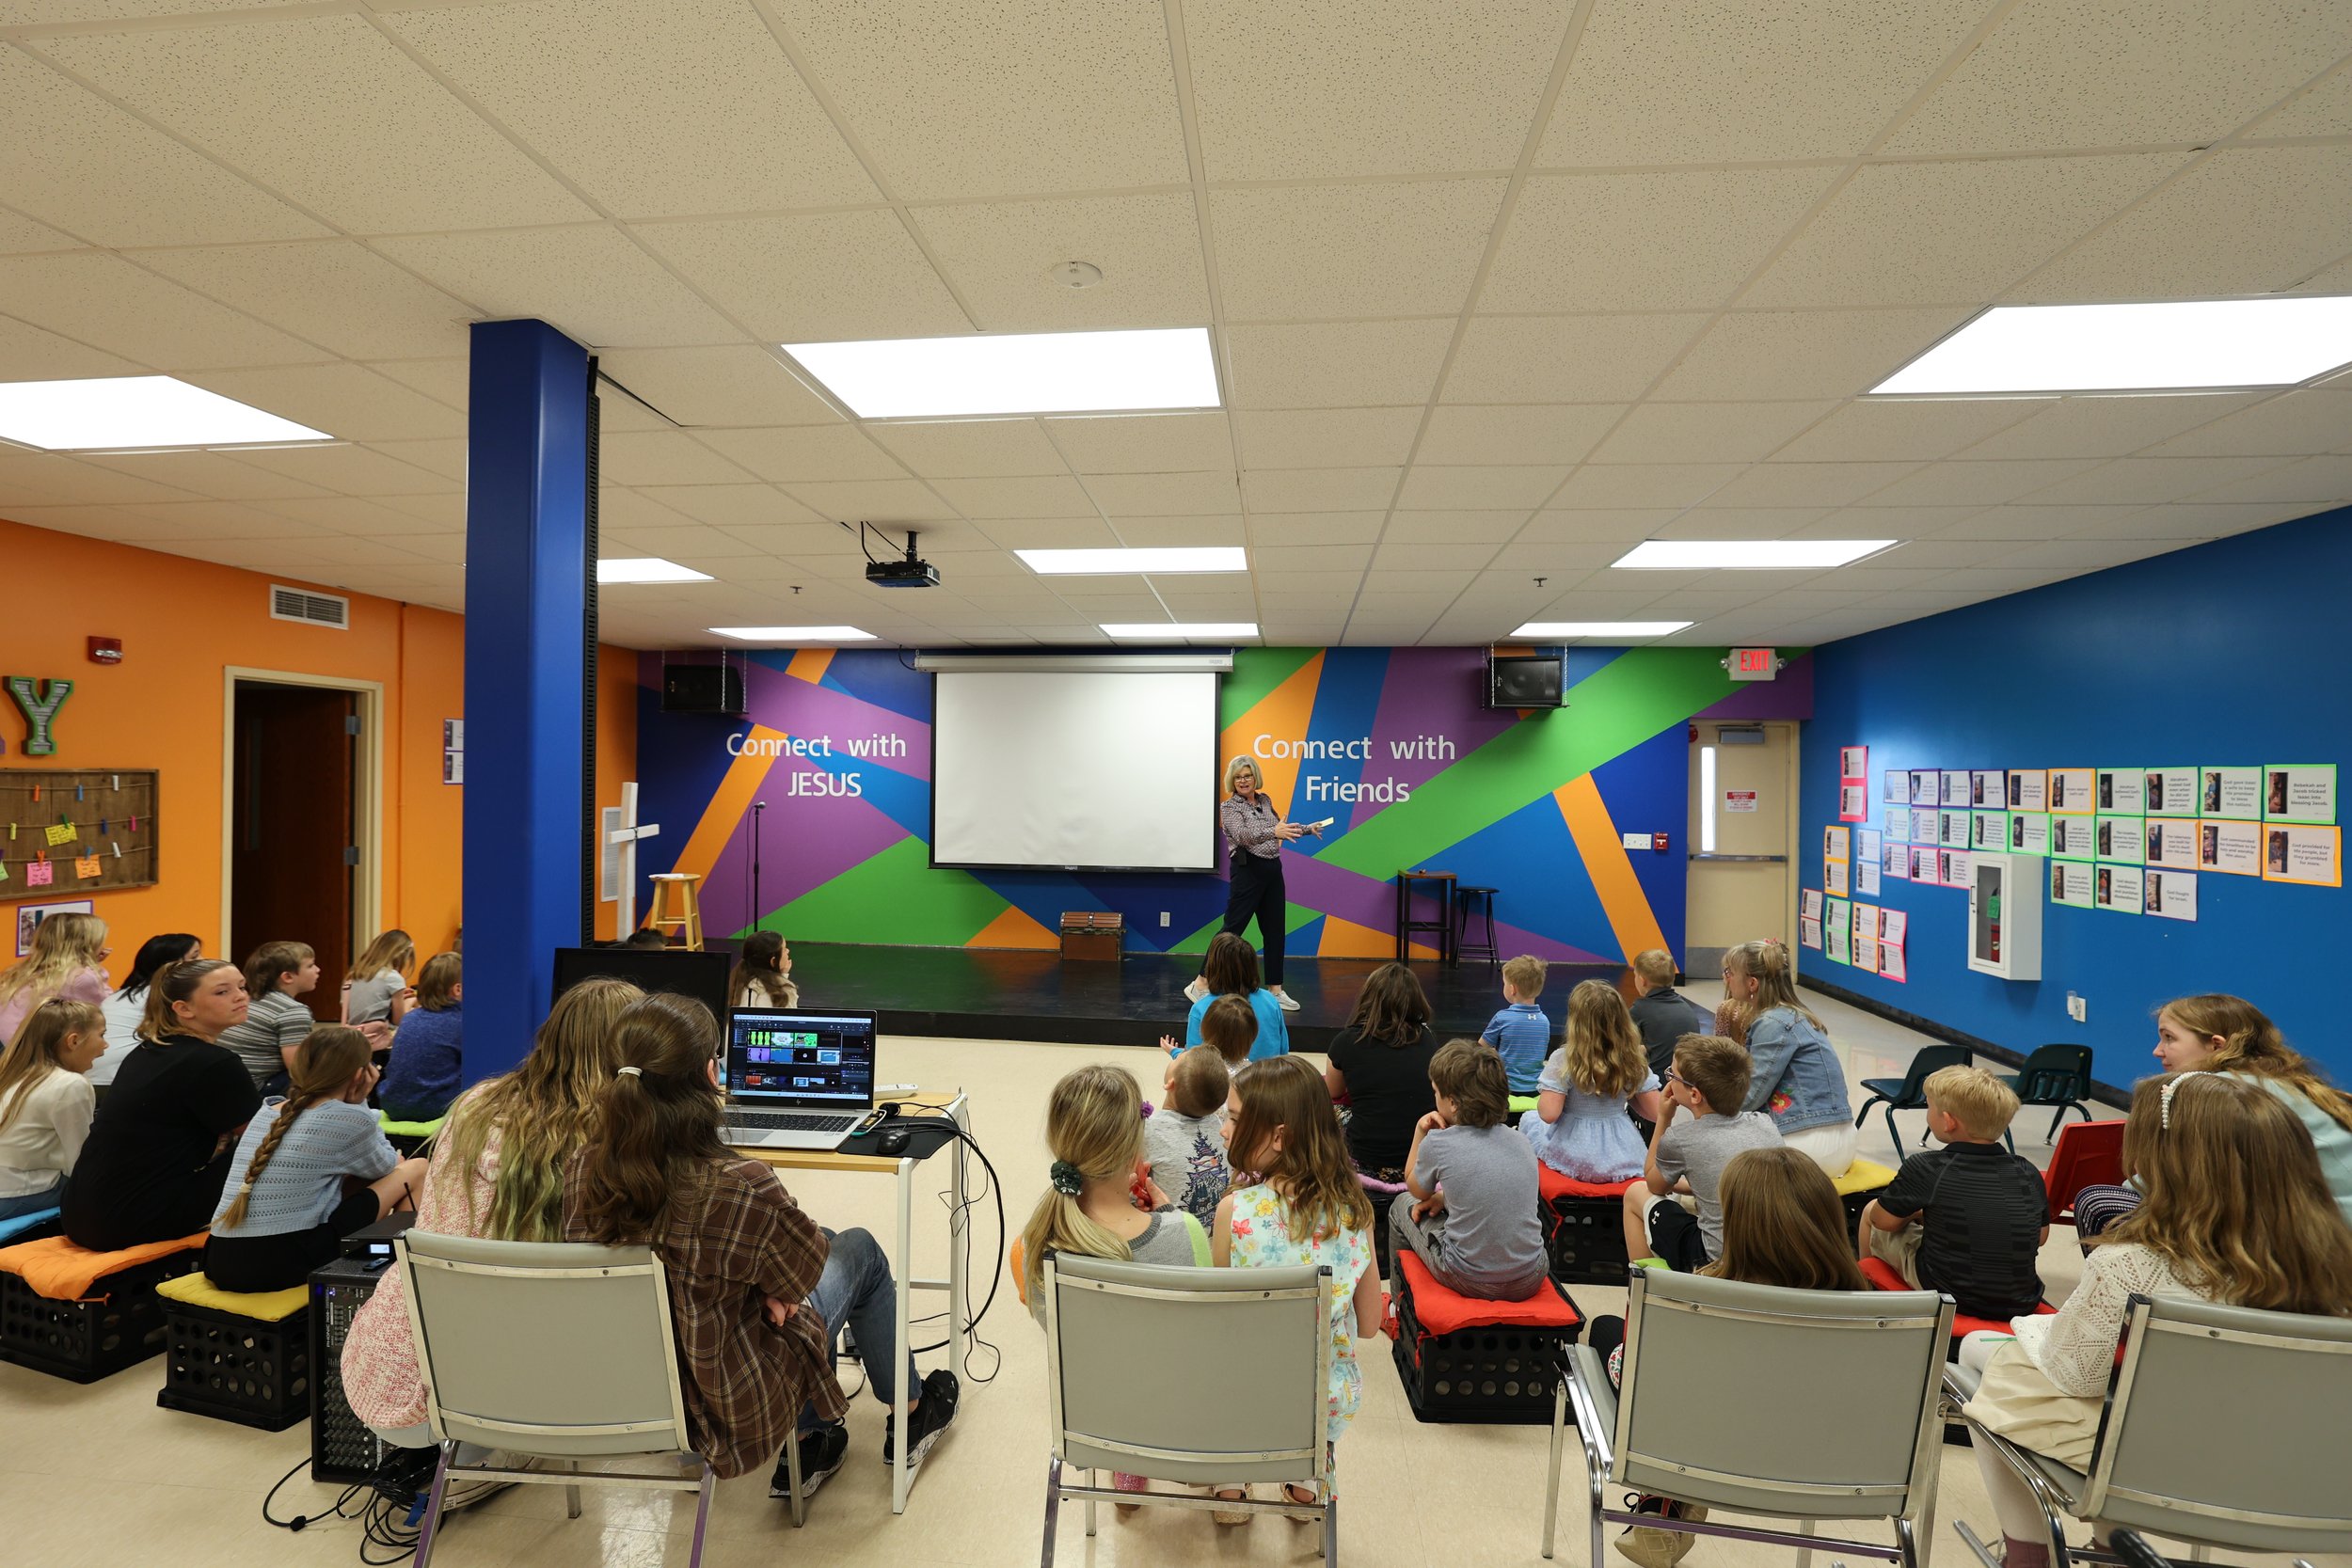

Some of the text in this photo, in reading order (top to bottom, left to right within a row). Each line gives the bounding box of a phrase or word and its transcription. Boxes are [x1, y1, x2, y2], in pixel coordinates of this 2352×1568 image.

[1740, 650, 1770, 672] EXIT
[725, 733, 907, 758] Connect with
[1252, 734, 1456, 760] Connect with
[787, 771, 863, 799] JESUS
[1306, 775, 1411, 804] Friends
